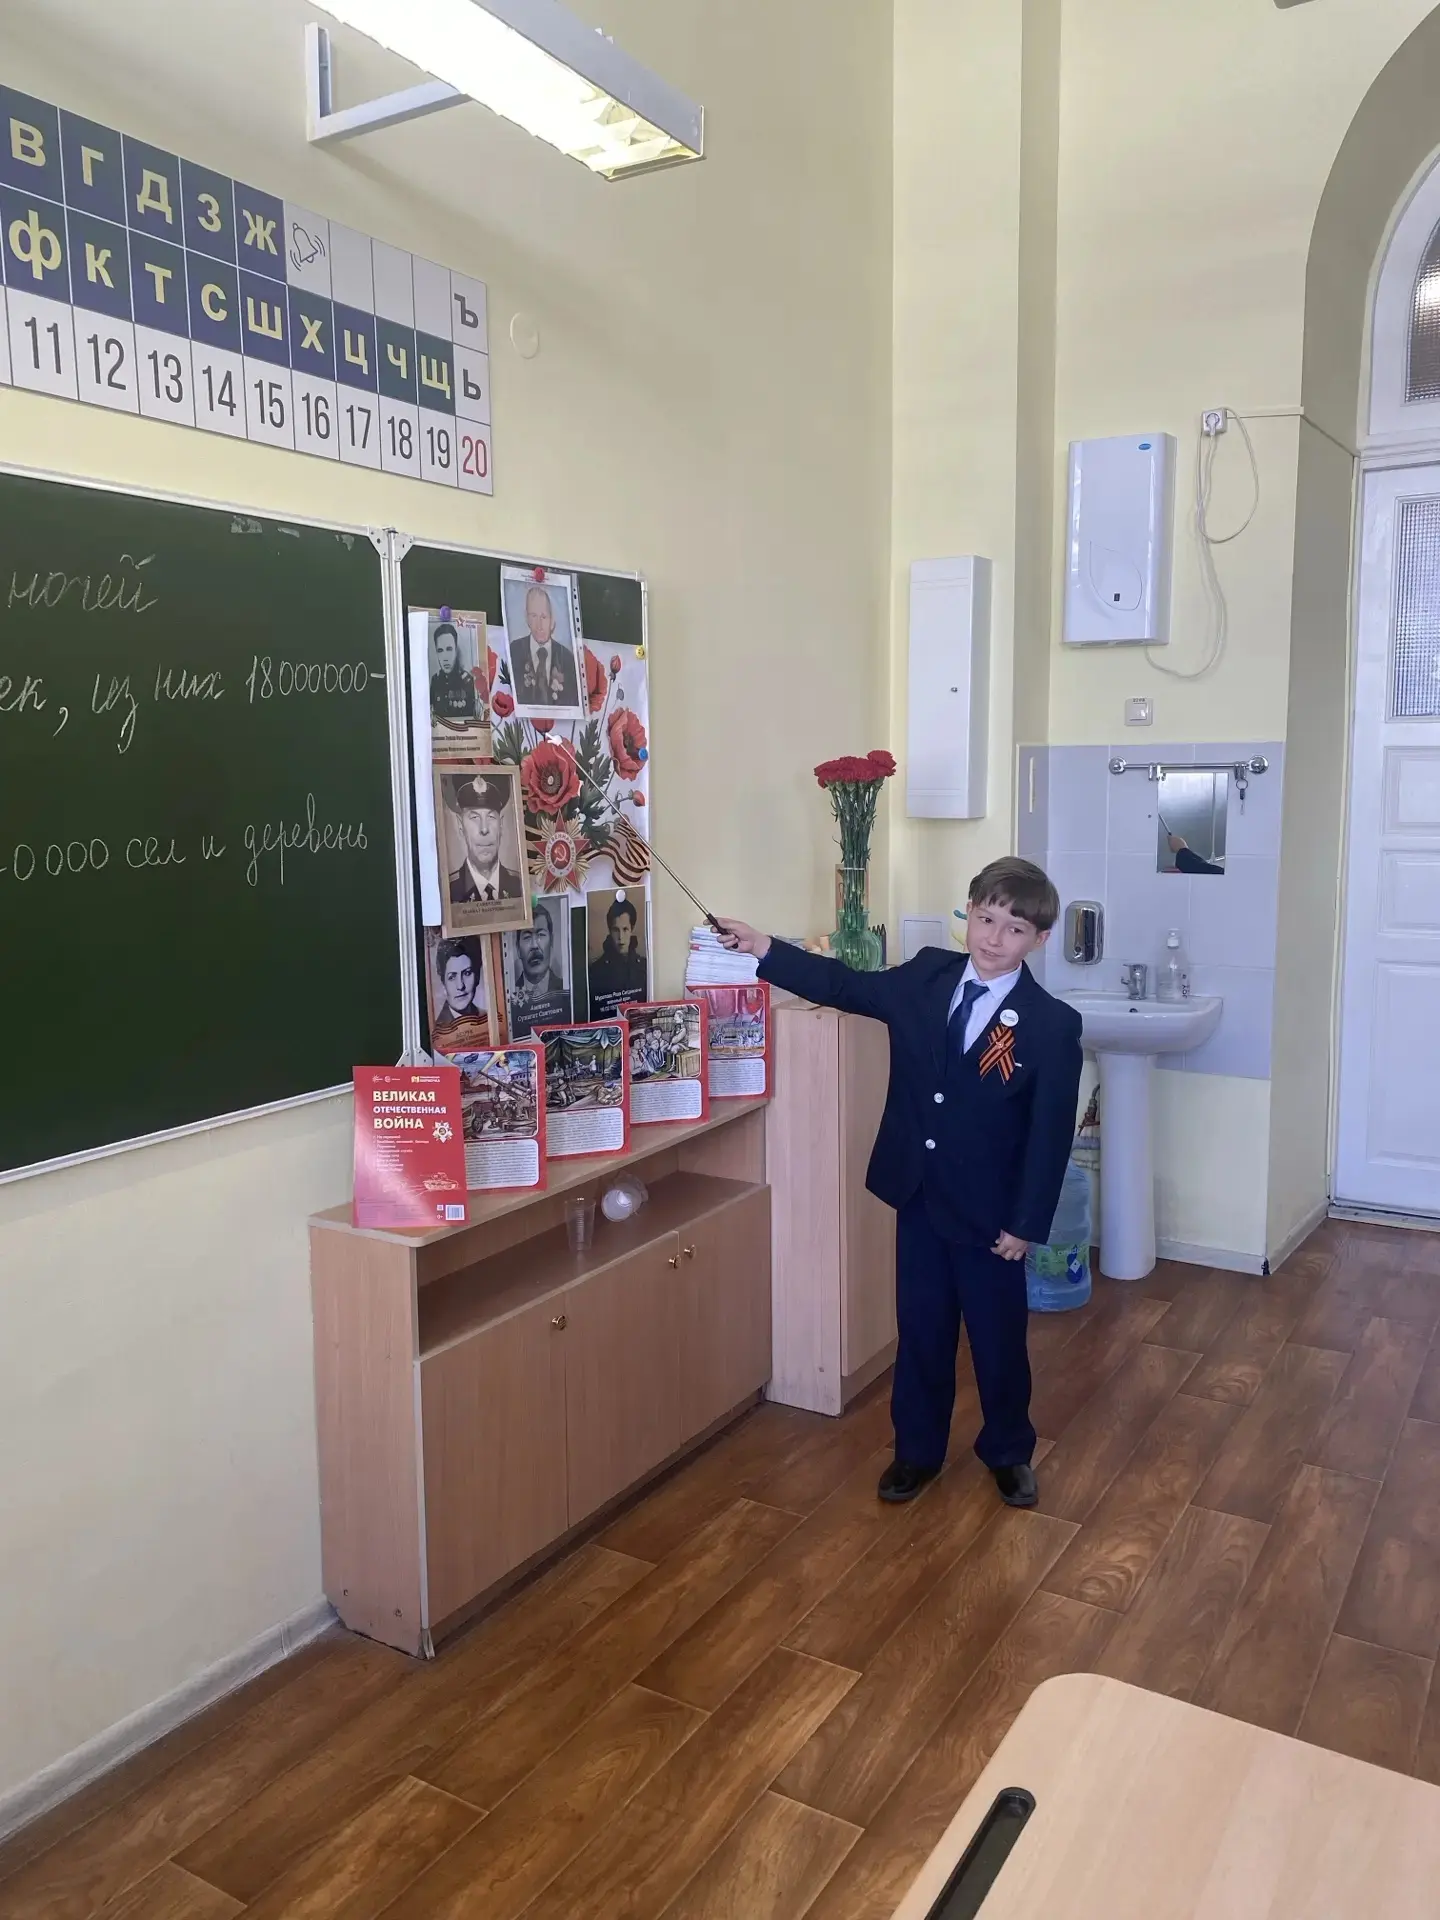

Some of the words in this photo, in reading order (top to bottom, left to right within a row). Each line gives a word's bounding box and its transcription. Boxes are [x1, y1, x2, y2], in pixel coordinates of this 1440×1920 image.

[24, 316, 62, 375] 11
[86, 332, 127, 390] 12
[147, 348, 183, 403] 13
[201, 364, 237, 417] 14
[253, 379, 285, 430] 15
[301, 391, 330, 440] 16
[345, 404, 372, 450] 17
[386, 415, 413, 460] 18
[426, 426, 451, 469] 19
[461, 435, 488, 478] 20
[126, 836, 187, 868] сел
[201, 835, 226, 860] и
[244, 793, 368, 886] деревень
[373, 1090, 436, 1102] ВЕЛИКАЯ
[373, 1106, 447, 1114] ОТЕЧЕСТВЕННАЯ
[373, 1115, 424, 1129] ВОЙНА
